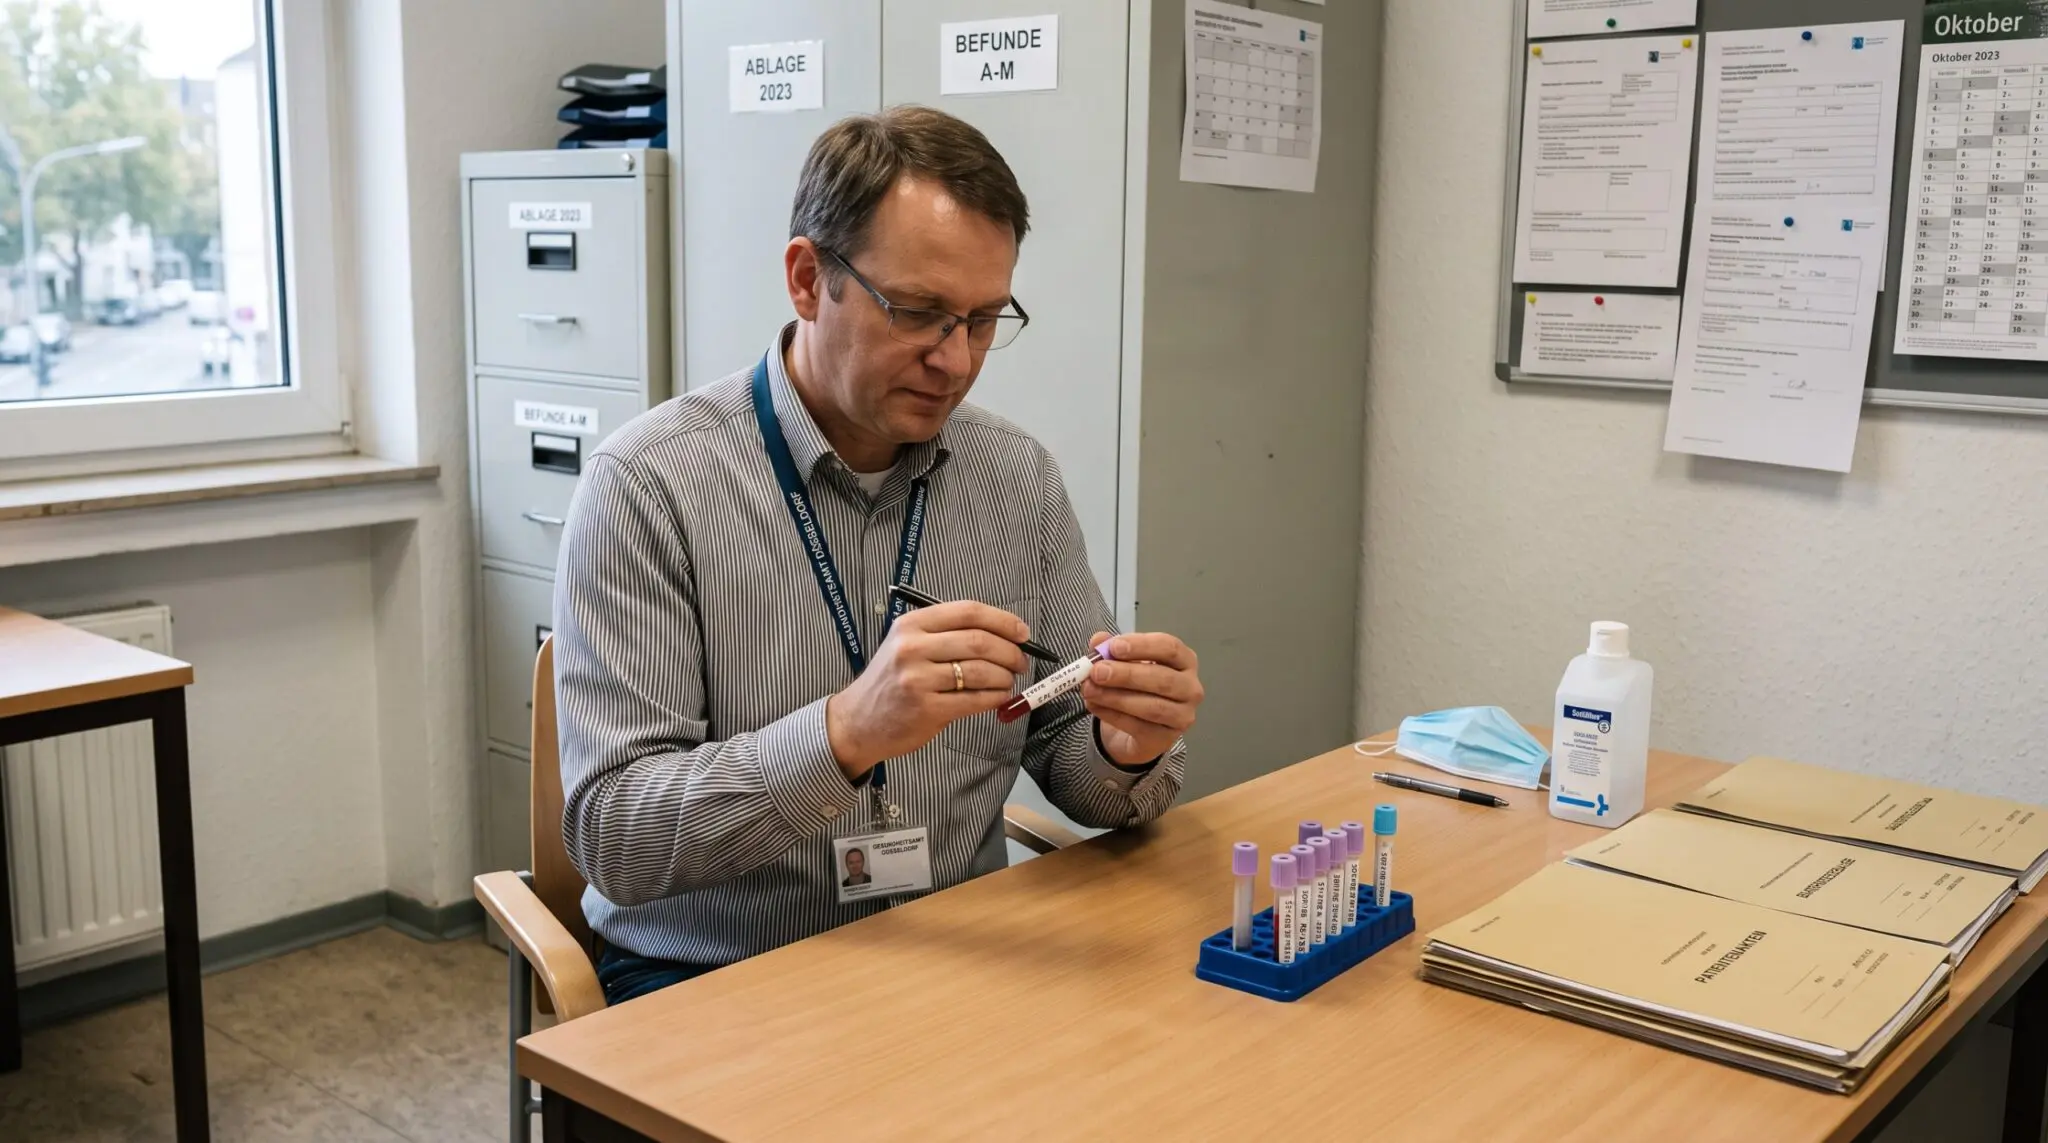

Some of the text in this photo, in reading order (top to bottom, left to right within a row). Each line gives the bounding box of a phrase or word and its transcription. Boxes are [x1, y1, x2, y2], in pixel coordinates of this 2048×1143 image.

[1934, 12, 2023, 36] Oktober
[956, 28, 1041, 53] BEFUNDE
[745, 55, 806, 75] ABLAGE
[1932, 50, 2000, 63] Oktober 2023
[980, 61, 1014, 81] A-M
[760, 83, 792, 101] 2023
[520, 208, 557, 222] ABLAGE
[524, 408, 566, 425] BEFUNDE
